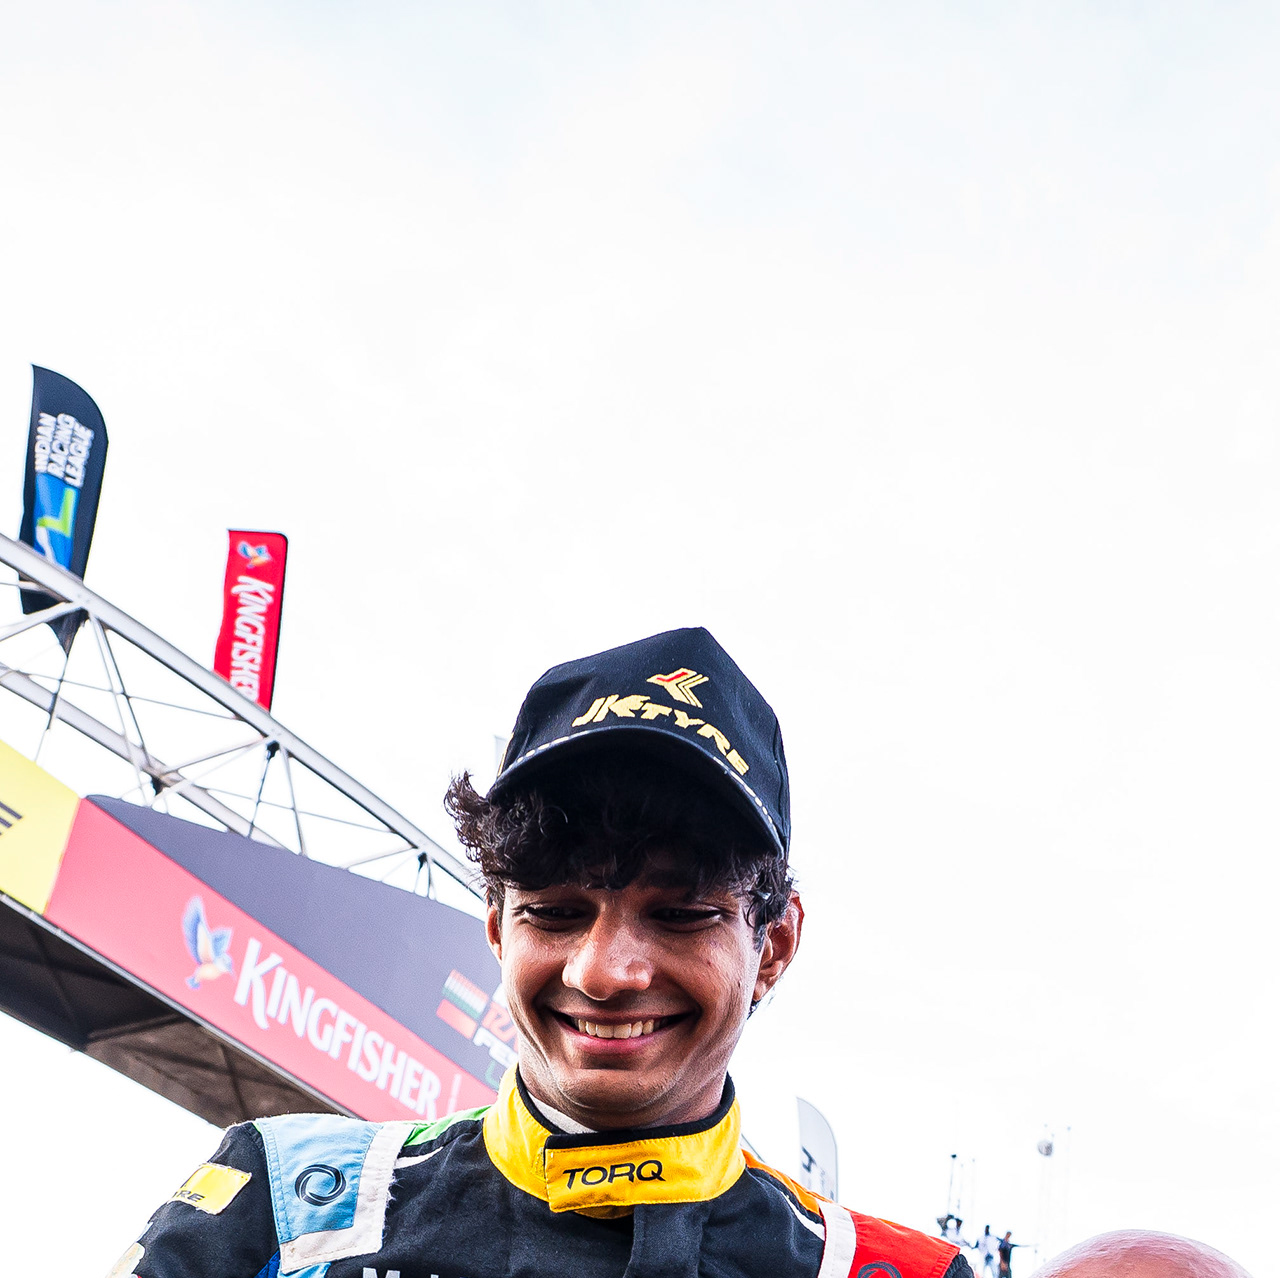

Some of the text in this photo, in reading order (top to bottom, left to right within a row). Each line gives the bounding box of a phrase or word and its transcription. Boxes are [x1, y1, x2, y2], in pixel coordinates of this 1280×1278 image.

[35, 412, 57, 473] INDIAN
[47, 413, 77, 479] RACING
[65, 427, 95, 488] LEAGUE
[232, 937, 443, 1120] KINGFISHER
[562, 1159, 666, 1190] TORQ
